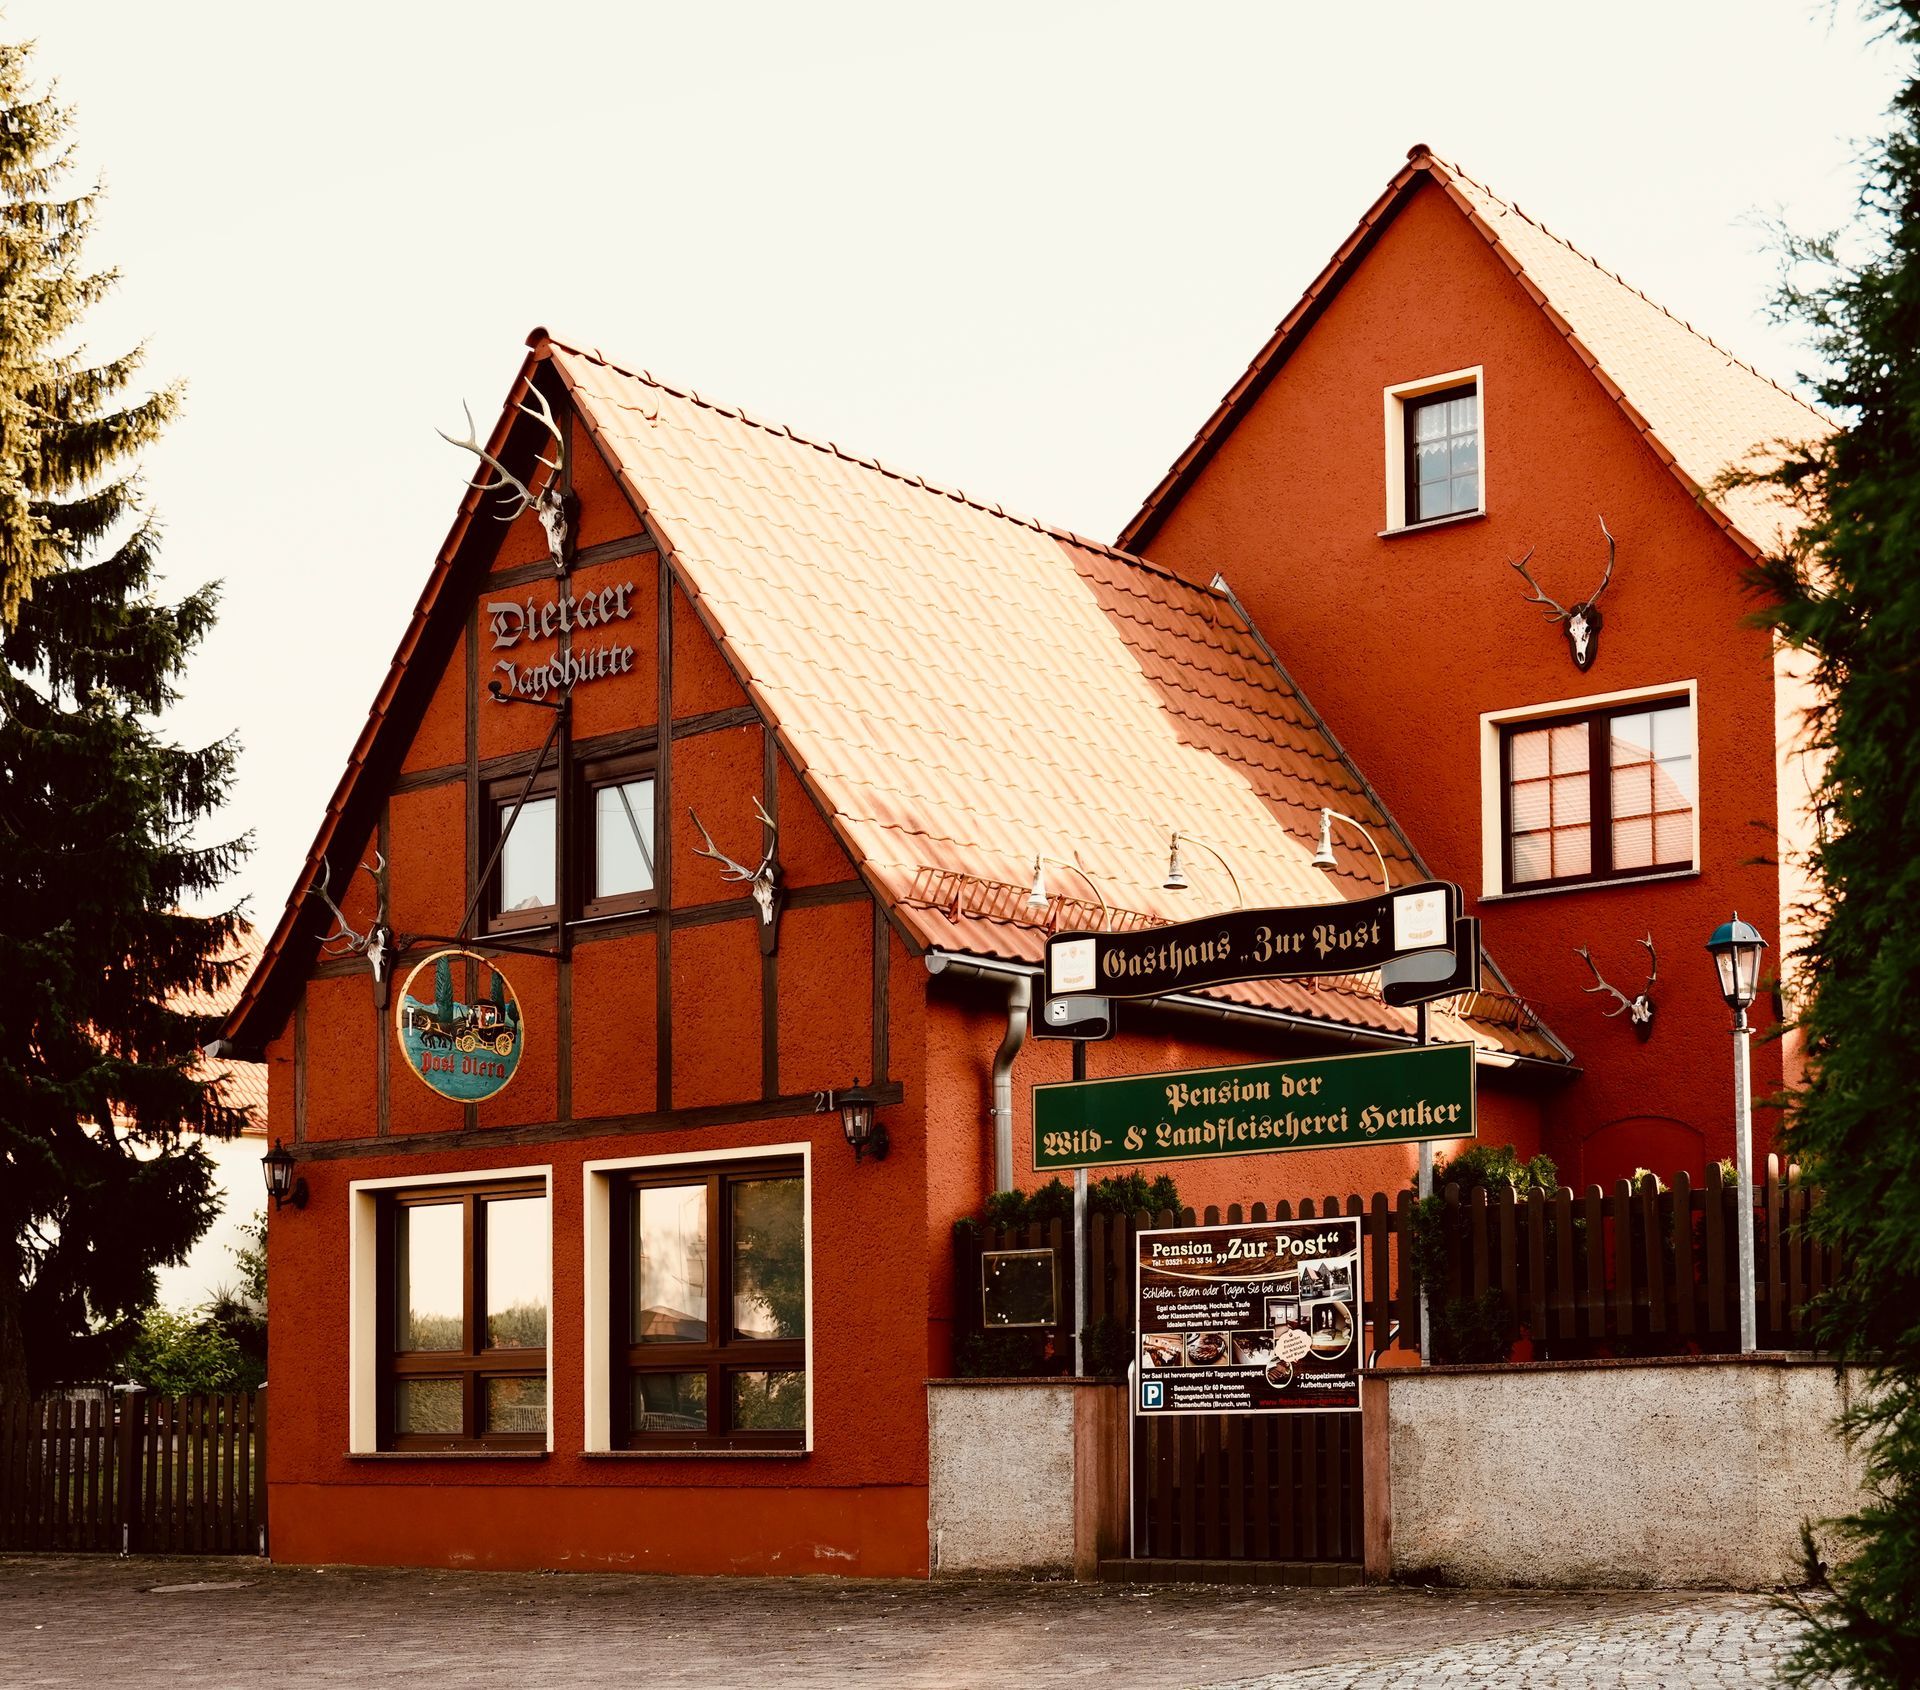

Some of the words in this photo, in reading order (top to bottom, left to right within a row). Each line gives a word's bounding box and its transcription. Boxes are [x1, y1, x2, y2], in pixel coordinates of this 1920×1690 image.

[486, 580, 634, 652] Dieraer
[486, 641, 634, 705] Jagdhütte
[1102, 929, 1231, 980] Gasthaus
[420, 1051, 454, 1076] Post
[814, 1089, 836, 1113] 21
[1165, 1076, 1271, 1116] Pension
[1281, 1072, 1324, 1097] der
[1043, 1126, 1113, 1158] Wild-
[1123, 1124, 1147, 1152] &
[1154, 1106, 1349, 1151] Landfleischerei
[1358, 1099, 1462, 1138] Henker
[1152, 1240, 1213, 1257] Pension
[1165, 1258, 1183, 1266] 03521
[1187, 1257, 1196, 1265] 73
[1178, 1285, 1200, 1298] Feiern
[1202, 1284, 1219, 1296] oder
[1221, 1282, 1246, 1299] Tagen
[1247, 1281, 1260, 1294] Sie
[1261, 1280, 1274, 1294] bei
[1276, 1280, 1292, 1293] uns!
[1156, 1305, 1168, 1313] Egal
[1171, 1371, 1204, 1380] hervorragend
[1214, 1370, 1240, 1379] Tagungen
[1300, 1381, 1332, 1389] Aufbettung
[1332, 1380, 1356, 1389] möglich
[1305, 1372, 1346, 1381] Doppelzimmer
[1147, 1385, 1160, 1405] P
